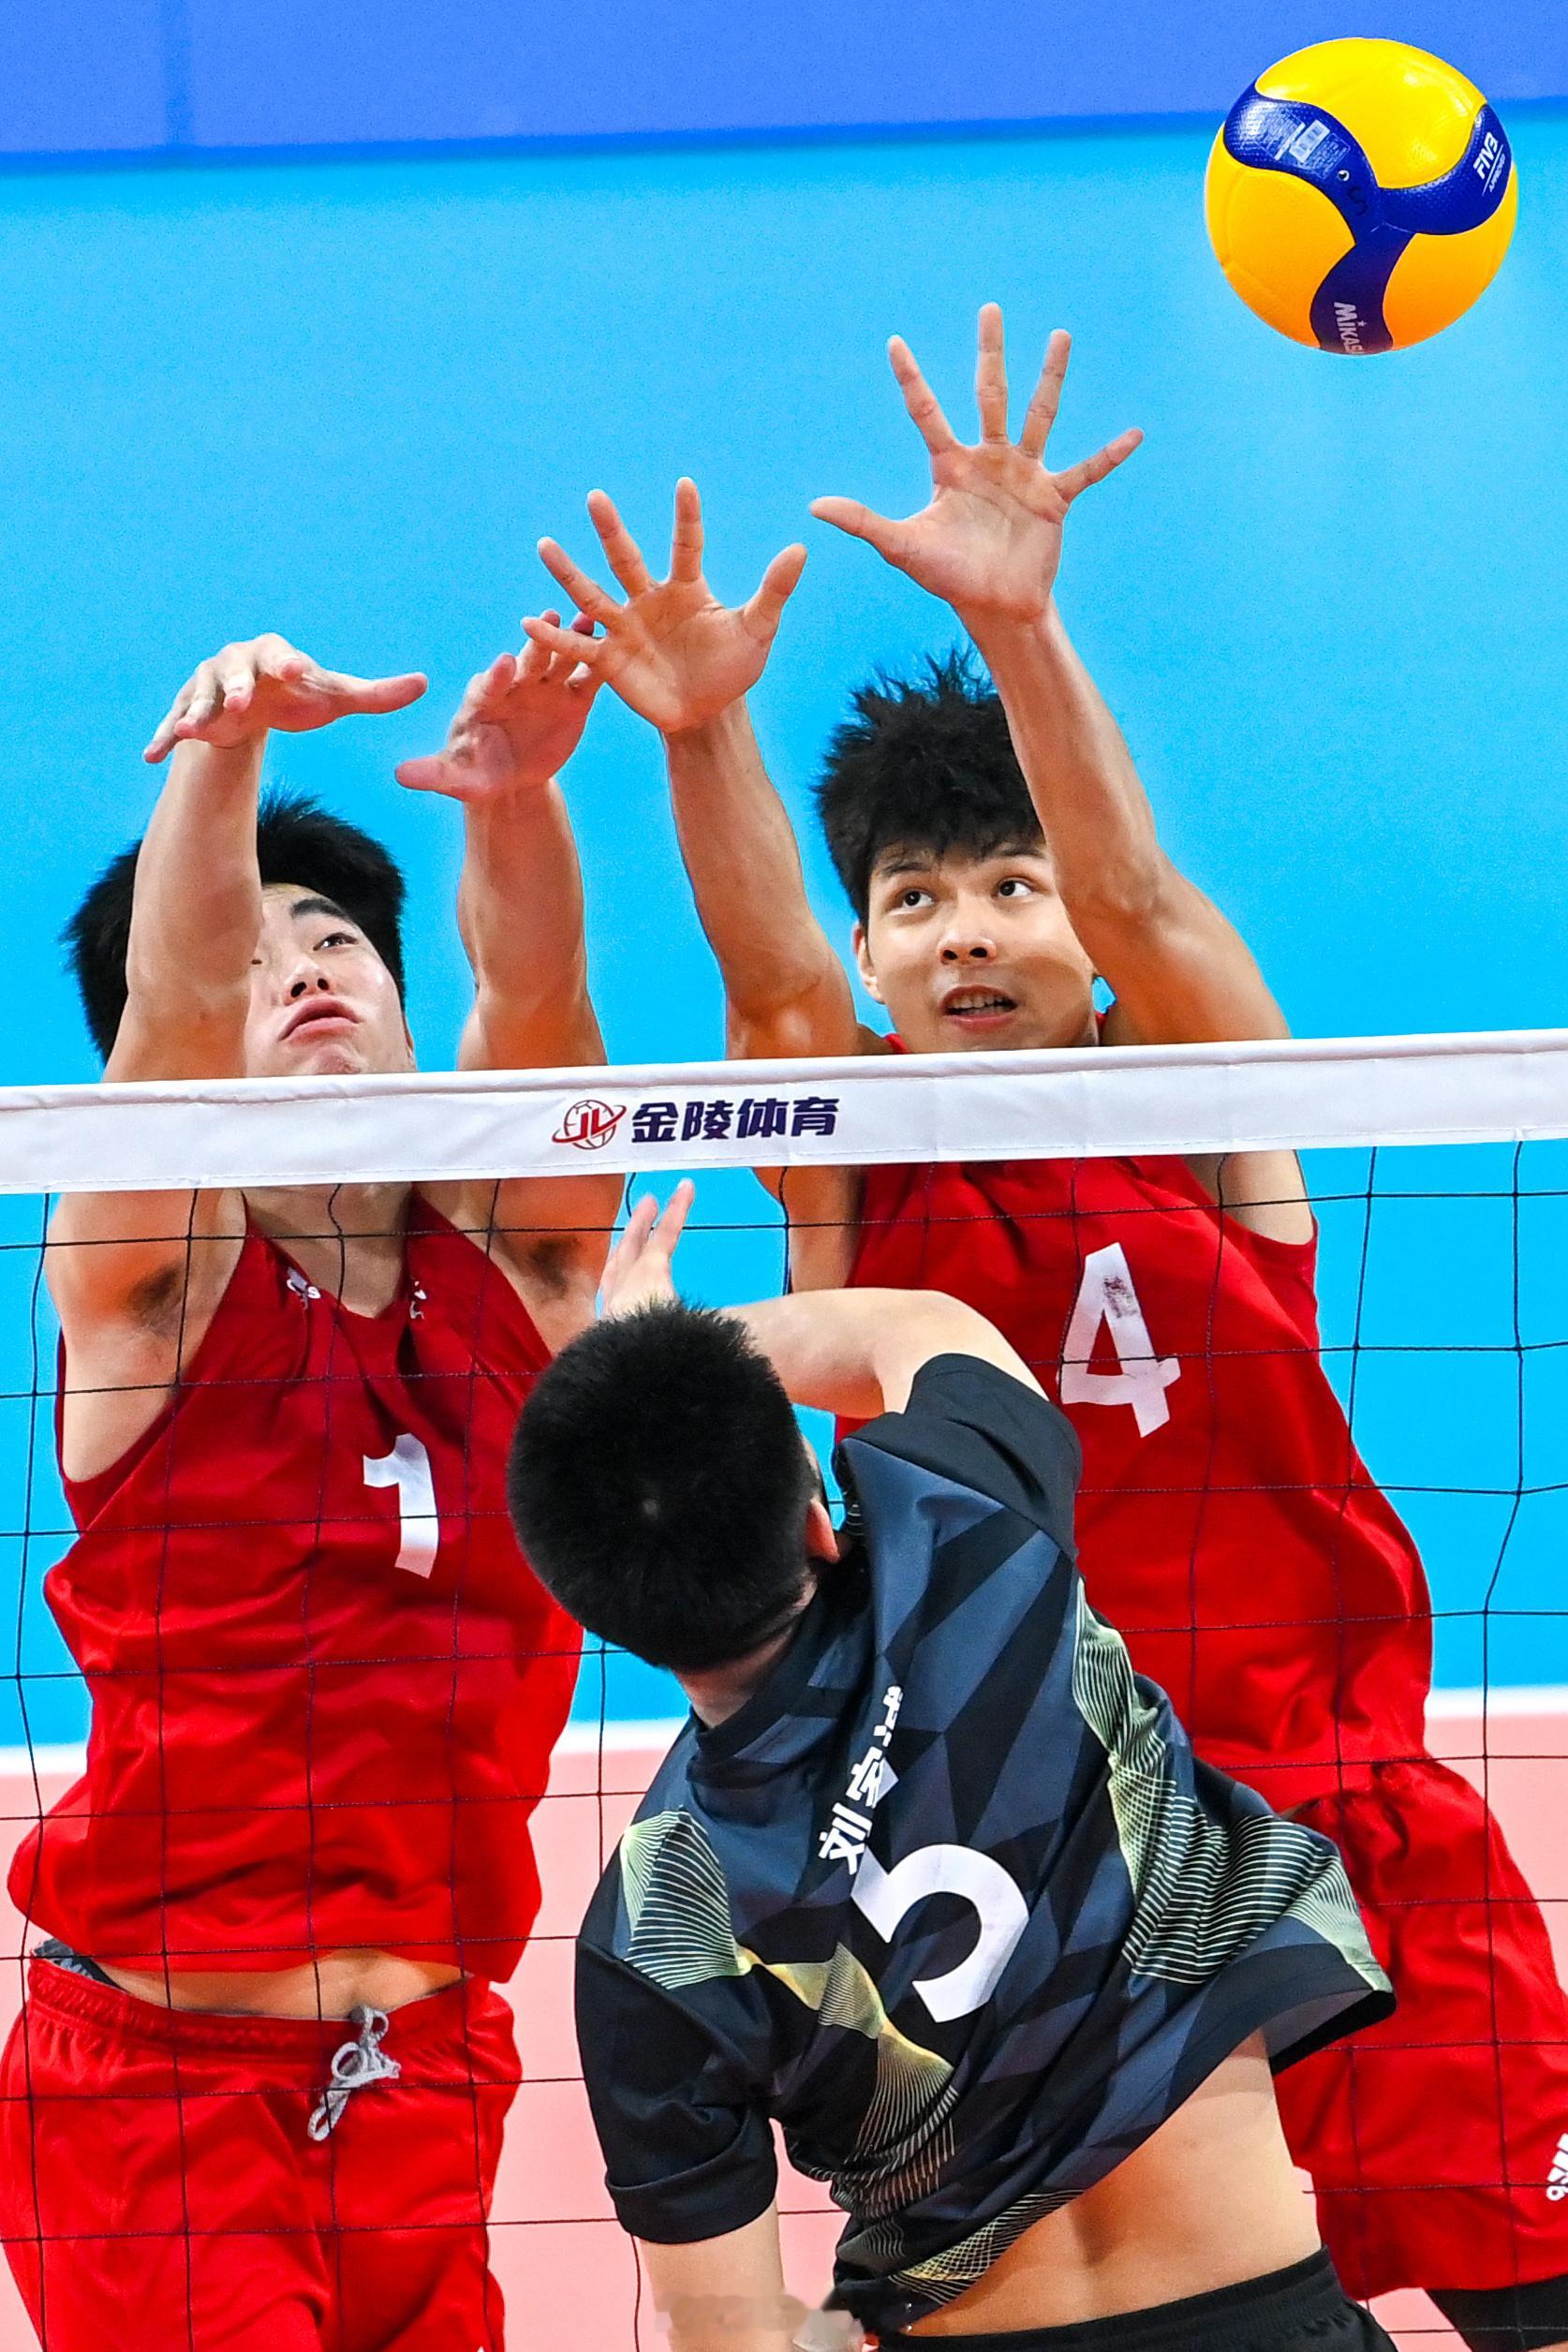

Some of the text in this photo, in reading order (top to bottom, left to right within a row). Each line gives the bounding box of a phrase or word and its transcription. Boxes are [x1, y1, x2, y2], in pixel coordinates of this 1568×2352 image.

[1473, 132, 1498, 180] FIVB
[631, 1096, 840, 1144] 金陵体育
[1056, 1241, 1182, 1439] 4
[362, 1432, 439, 1580] 1
[851, 1842, 1030, 2024] 5
